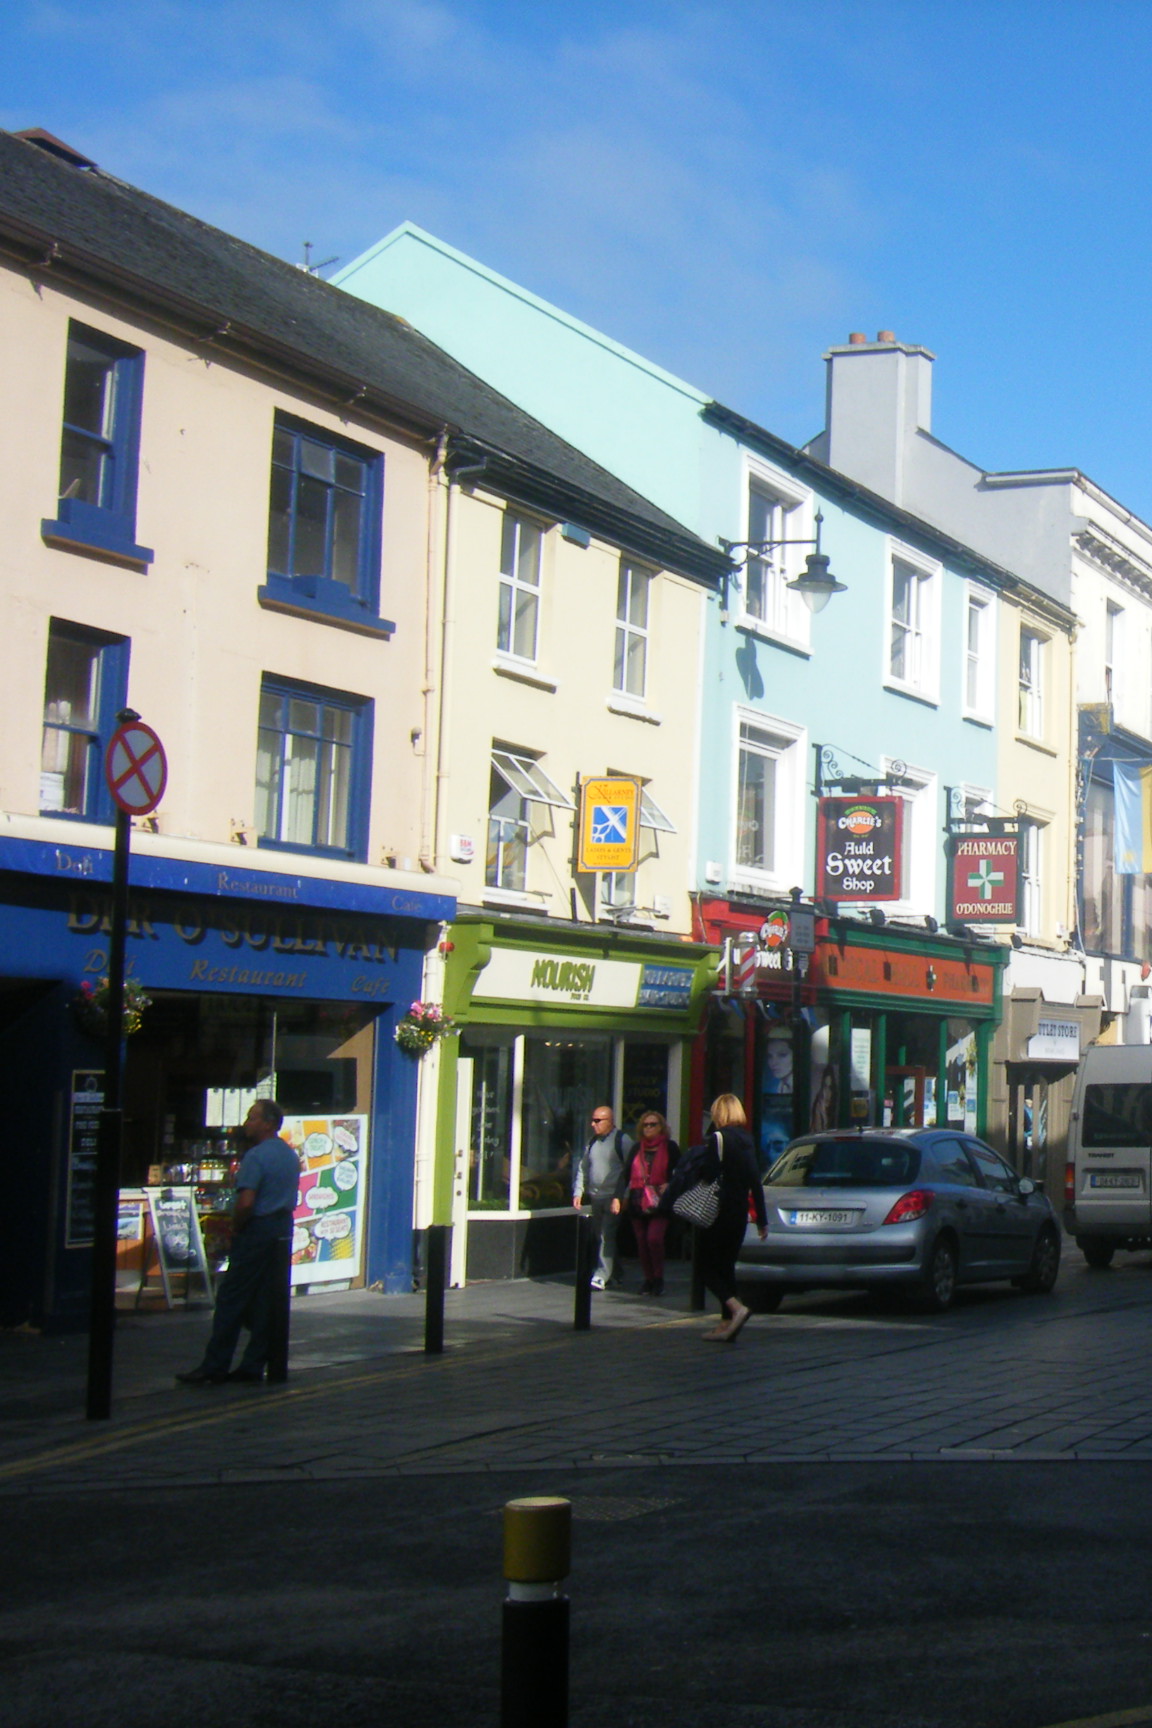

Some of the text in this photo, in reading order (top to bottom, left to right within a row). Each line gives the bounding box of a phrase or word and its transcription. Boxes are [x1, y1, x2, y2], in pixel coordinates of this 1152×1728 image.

[838, 815, 882, 829] CHARLIE'S
[844, 841, 874, 855] Auld
[958, 841, 1017, 856] PHARMACY
[825, 852, 892, 876] Sweet
[217, 872, 299, 899] Restaurant
[842, 876, 875, 893] Shop
[956, 903, 1014, 915] O'DONOGHUE
[190, 959, 308, 988] Restaurant
[530, 958, 596, 994] NOURISH
[1057, 1024, 1078, 1038] STORE
[799, 1212, 848, 1223] 11-KY-1091
